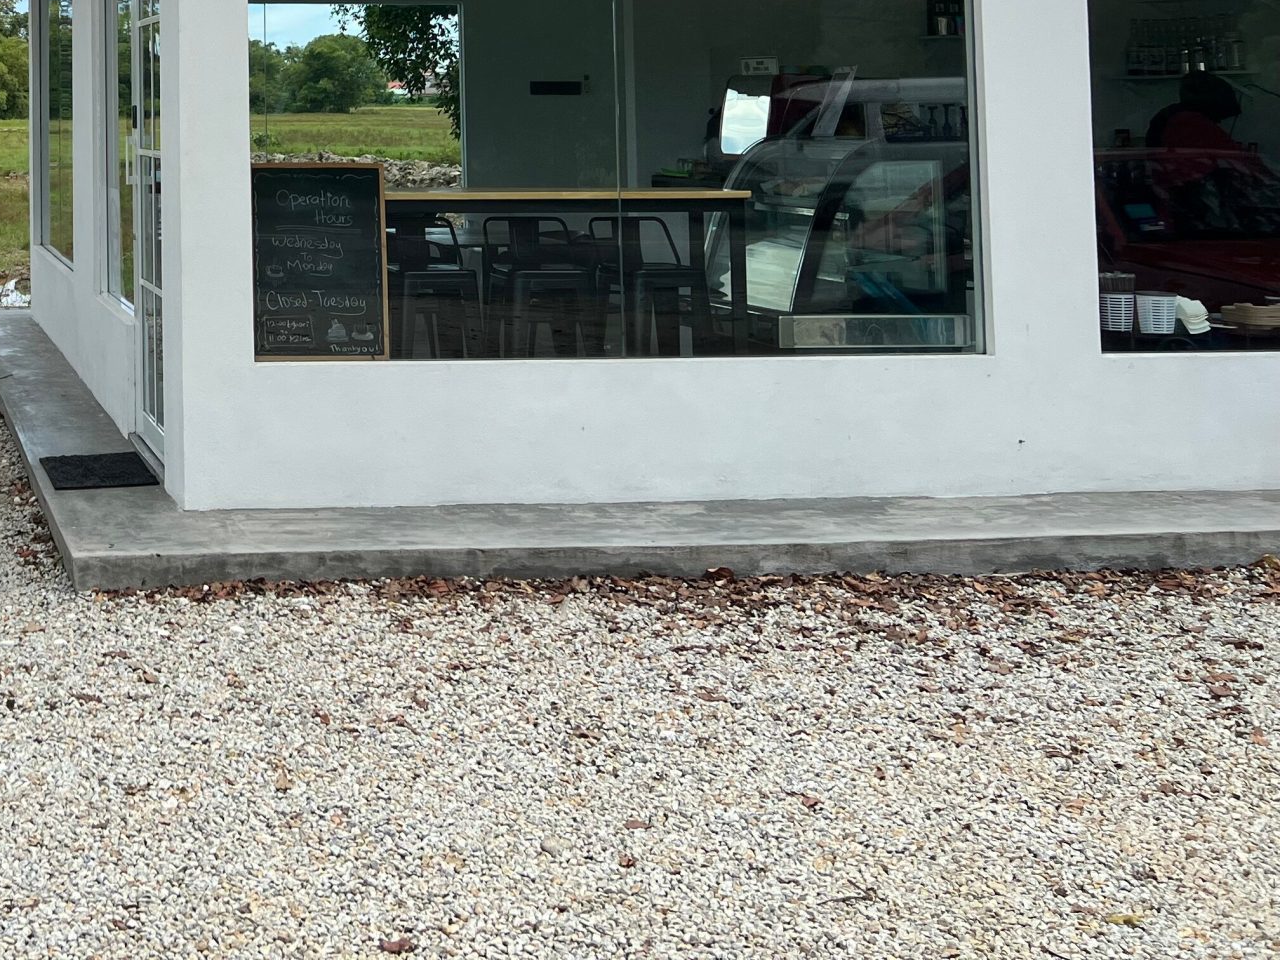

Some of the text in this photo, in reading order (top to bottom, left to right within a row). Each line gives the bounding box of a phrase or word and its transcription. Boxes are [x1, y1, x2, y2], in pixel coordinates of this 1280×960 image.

[275, 189, 352, 211] Operation
[315, 209, 353, 226] Hours
[272, 234, 344, 258] Wednesday
[287, 259, 334, 275] Monday
[311, 290, 367, 315] Tuesday
